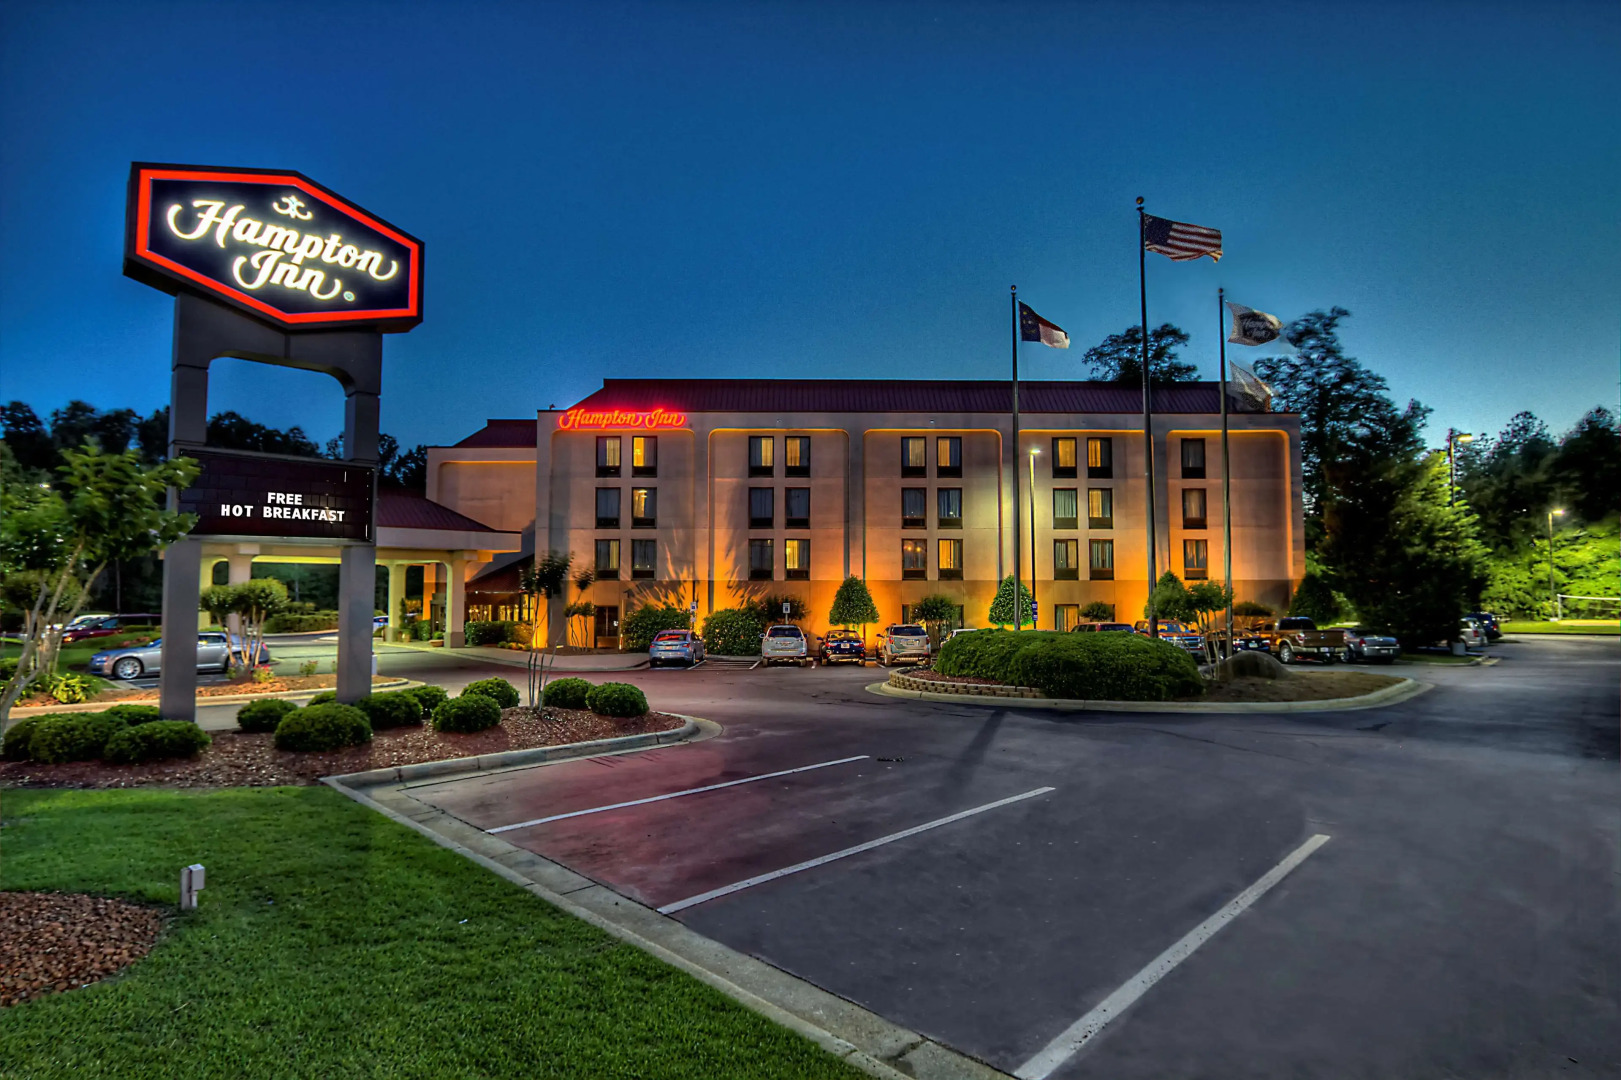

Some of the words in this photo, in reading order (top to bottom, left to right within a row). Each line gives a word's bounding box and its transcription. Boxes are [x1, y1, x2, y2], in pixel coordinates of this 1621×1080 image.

[167, 200, 398, 281] Hampton
[232, 250, 342, 300] Inn
[559, 408, 643, 429] Hampton
[645, 409, 685, 429] Inn
[267, 491, 303, 506] FREE
[220, 504, 254, 518] HOT
[263, 506, 345, 522] BREAKFAST
